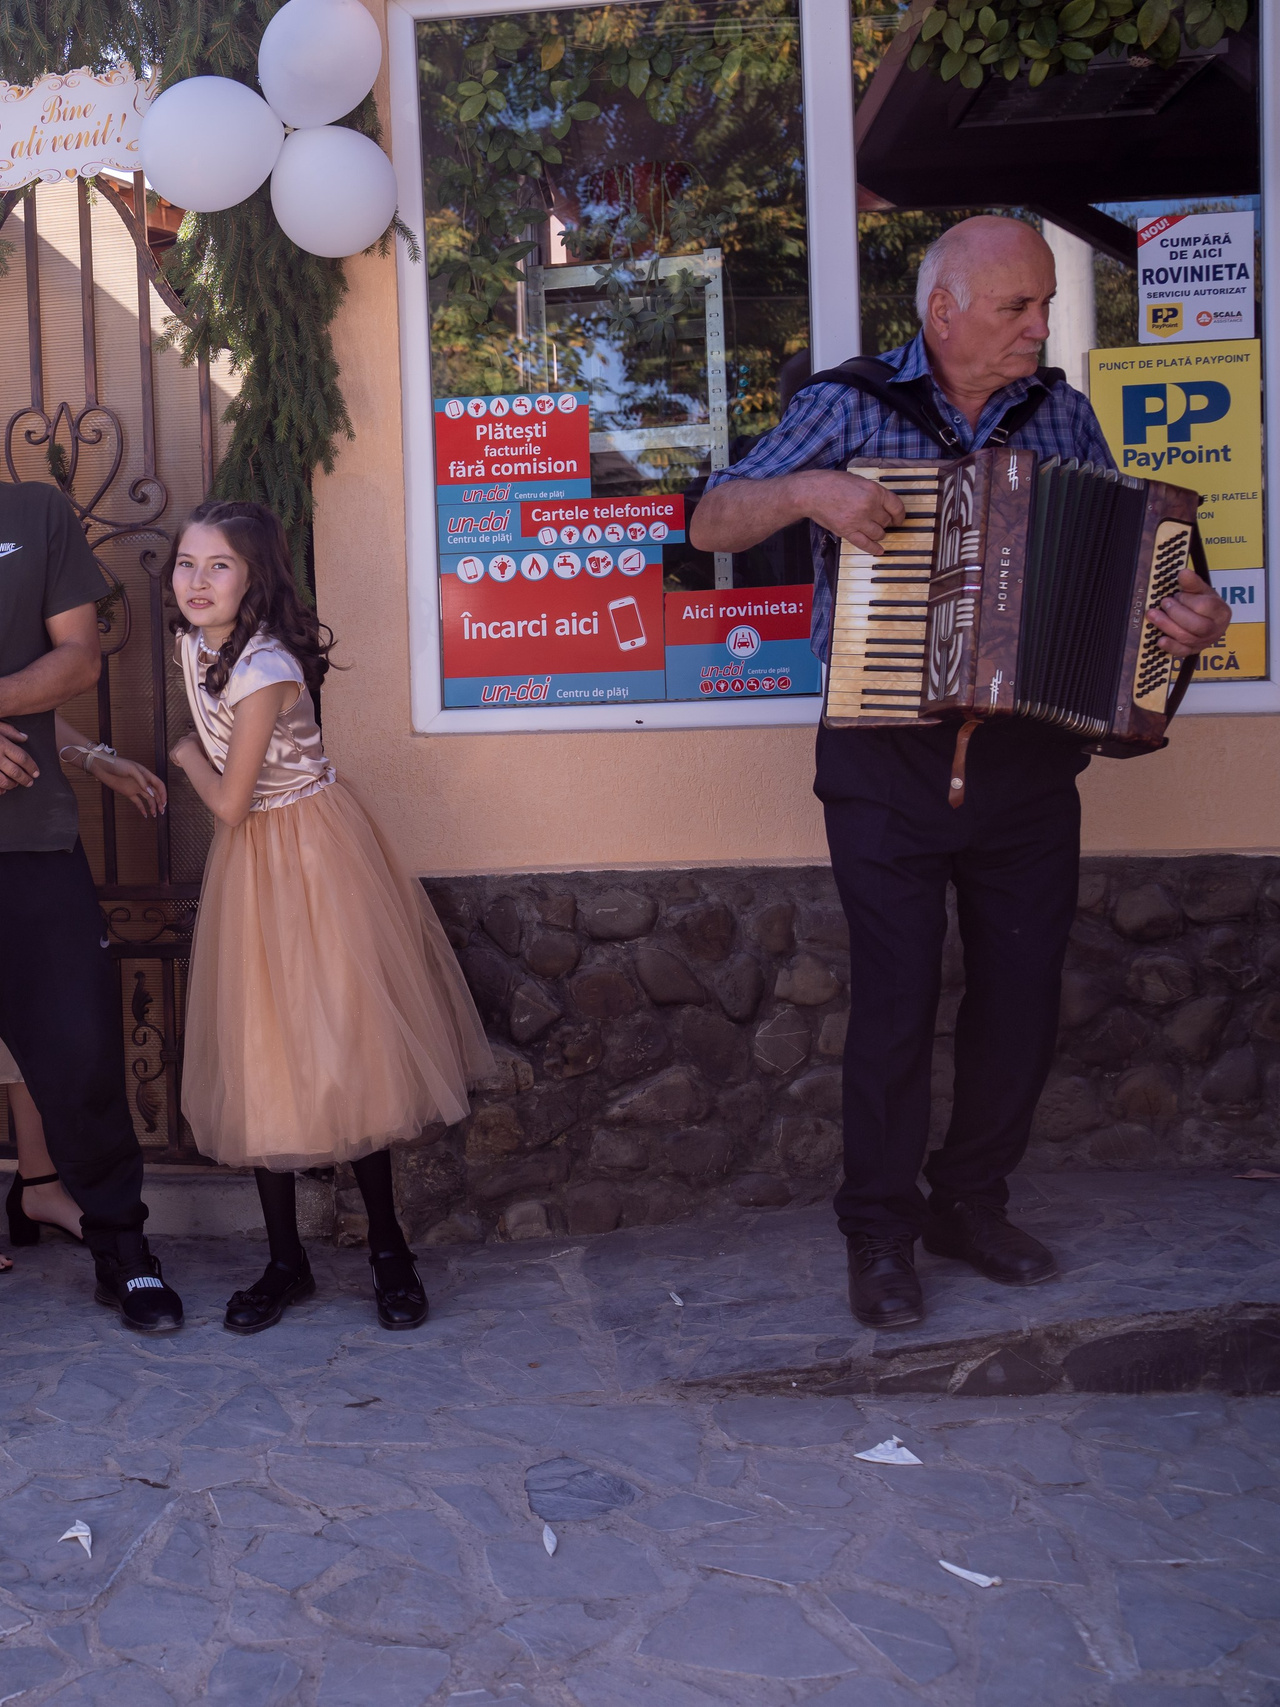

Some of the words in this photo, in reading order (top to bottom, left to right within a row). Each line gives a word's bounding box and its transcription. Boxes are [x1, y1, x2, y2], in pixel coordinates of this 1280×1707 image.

[41, 95, 96, 124] Bine
[1140, 218, 1170, 241] NOU!
[1160, 232, 1232, 248] CUMPĂRĂ
[1170, 250, 1188, 260] DE
[1192, 248, 1222, 259] AICI
[1142, 263, 1250, 286] ROVINIETA
[1146, 290, 1191, 299] SERVICIU
[1193, 287, 1247, 296] AUTORIZAT
[1152, 322, 1179, 330] PayPoint
[1099, 361, 1136, 371] PUNCT
[1138, 360, 1153, 369] DE
[1156, 356, 1192, 368] PLATĂ
[1195, 353, 1251, 365] PAYPOINT
[484, 443, 541, 457] facturile
[1123, 444, 1232, 472] PayPoint
[449, 460, 485, 478] fără
[491, 457, 577, 476] comision
[462, 483, 511, 502] un-doi
[514, 491, 537, 499] Centru
[539, 491, 547, 499] de
[1221, 492, 1258, 501] RATELE
[447, 508, 511, 534] un-doi
[531, 506, 589, 522] Cartele
[593, 503, 674, 518] telefonice
[1196, 511, 1215, 519] ION
[0, 542, 16, 551] NIKE
[447, 535, 478, 544] Centru
[479, 534, 490, 544] de
[1205, 536, 1247, 545] MOBILUL
[997, 547, 1011, 612] HOHNER
[682, 604, 714, 620] Aici
[719, 601, 804, 618] rovinieta:
[460, 611, 547, 640] Încarci
[555, 611, 599, 636] aici
[700, 660, 745, 678] un-doi
[481, 676, 551, 702] un-doi
[556, 689, 589, 699] Centru
[592, 688, 604, 698] de
[126, 1277, 164, 1292] PUMA
